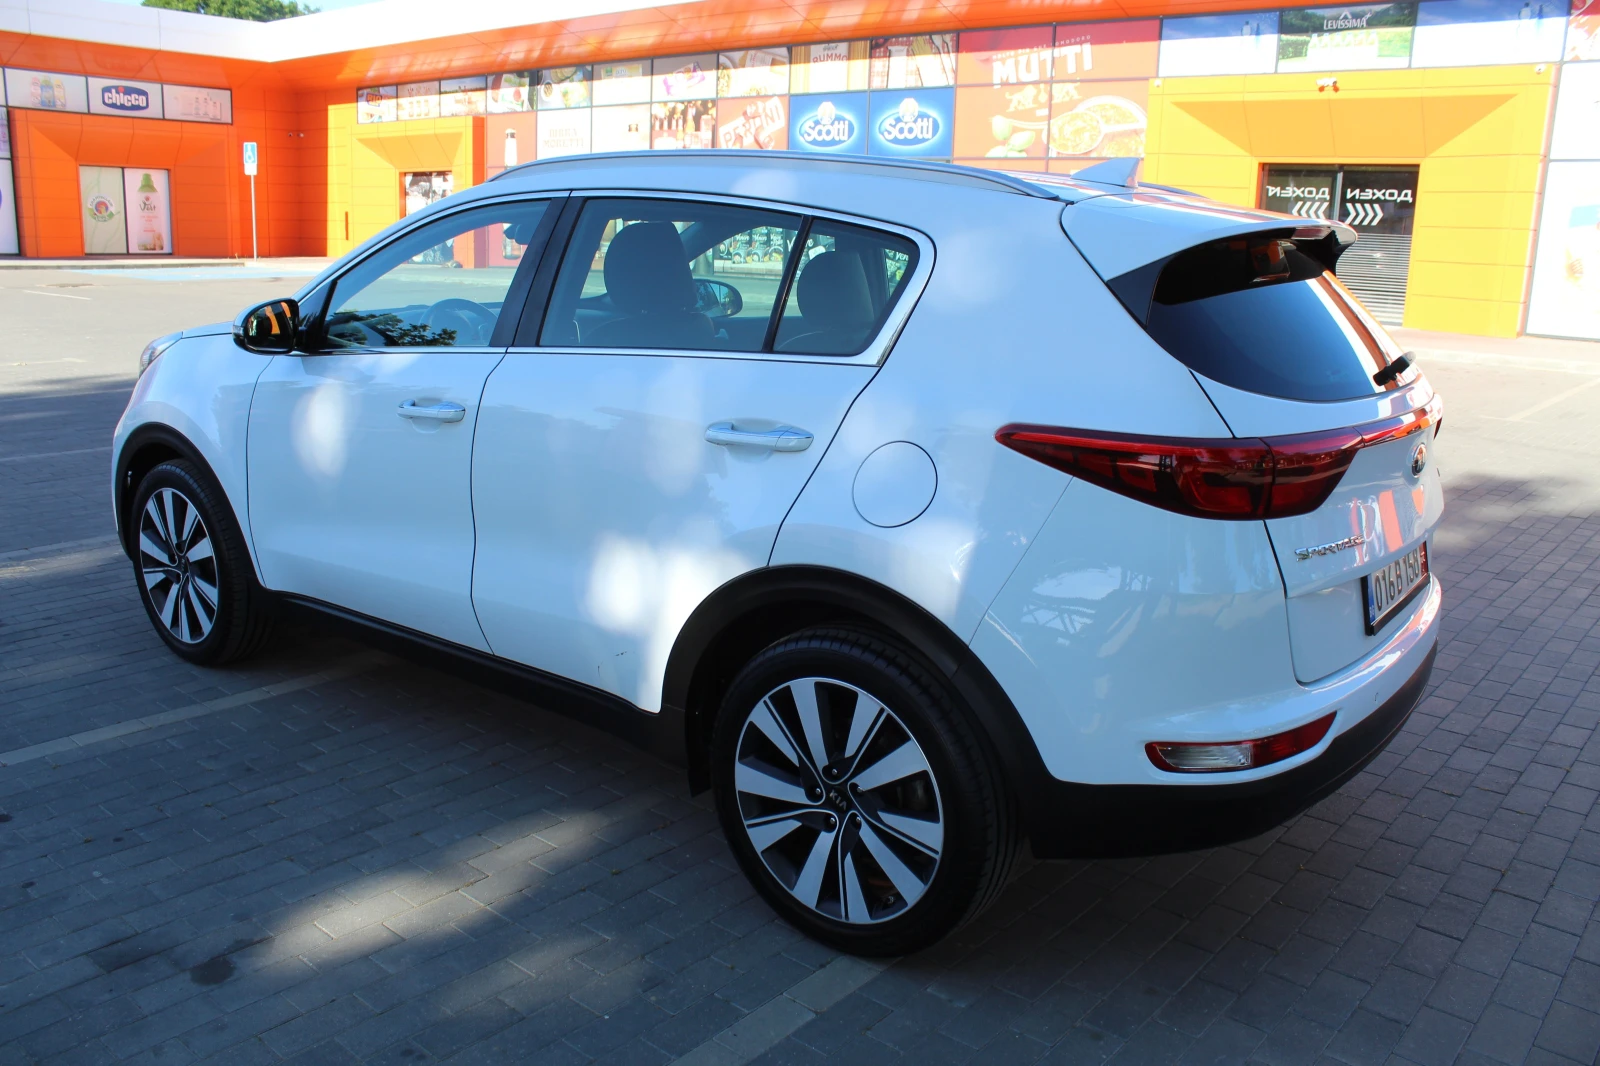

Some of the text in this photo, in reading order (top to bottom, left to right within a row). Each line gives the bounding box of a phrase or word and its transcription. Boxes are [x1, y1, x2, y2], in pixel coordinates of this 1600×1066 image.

[1323, 18, 1367, 30] LEVISSIMA
[812, 52, 849, 63] RUMMO
[992, 41, 1093, 89] MUTTI
[104, 86, 147, 107] chicco
[803, 120, 849, 142] Scotti
[883, 117, 933, 141] Scotti
[1266, 186, 1330, 200] ИЗХОД
[1346, 188, 1413, 203] ИЗХОД
[829, 789, 848, 811] KIA
